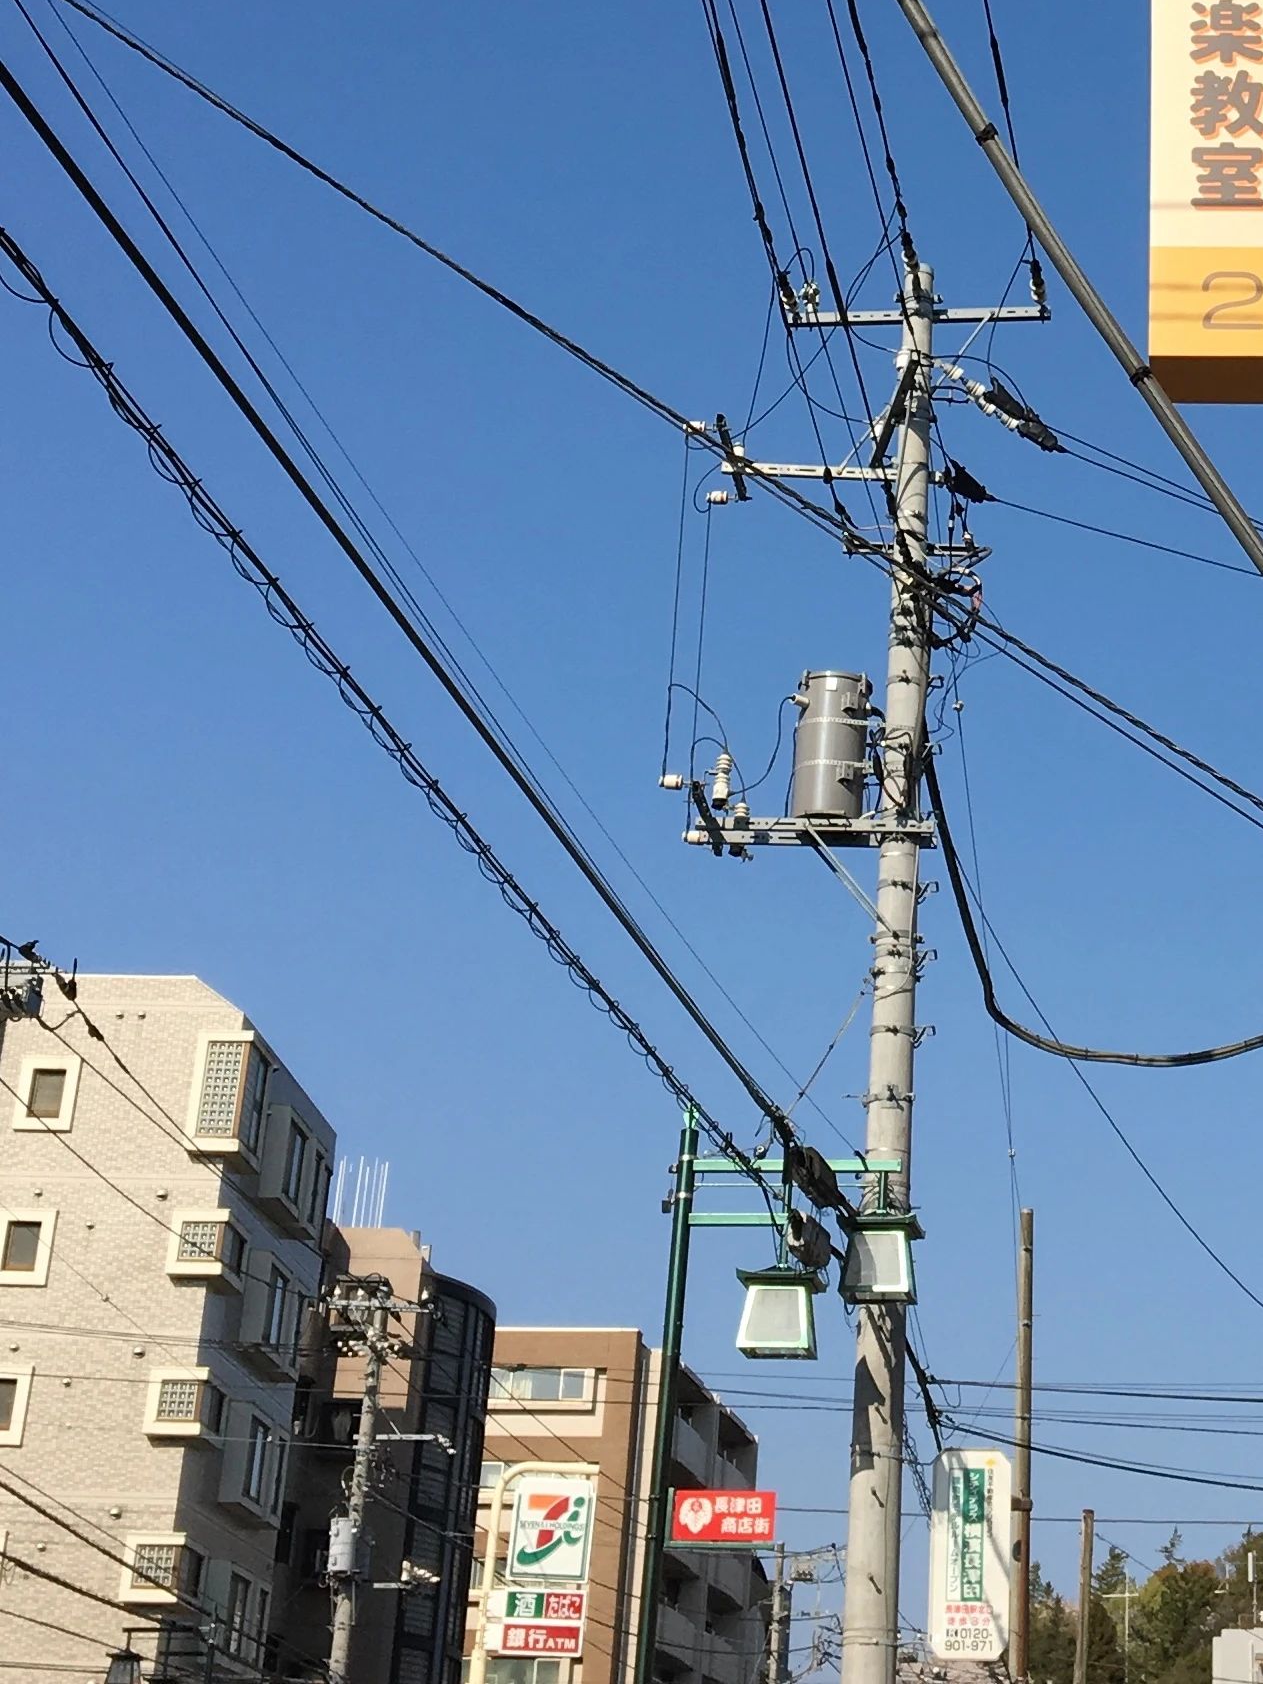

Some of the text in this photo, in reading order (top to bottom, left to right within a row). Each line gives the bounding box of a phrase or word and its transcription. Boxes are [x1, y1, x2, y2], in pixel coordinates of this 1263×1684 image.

[714, 1496, 763, 1515] 長津田
[721, 1516, 771, 1535] 商店街
[513, 1593, 581, 1619] 酒 たばこ
[944, 1639, 993, 1652] 901-971
